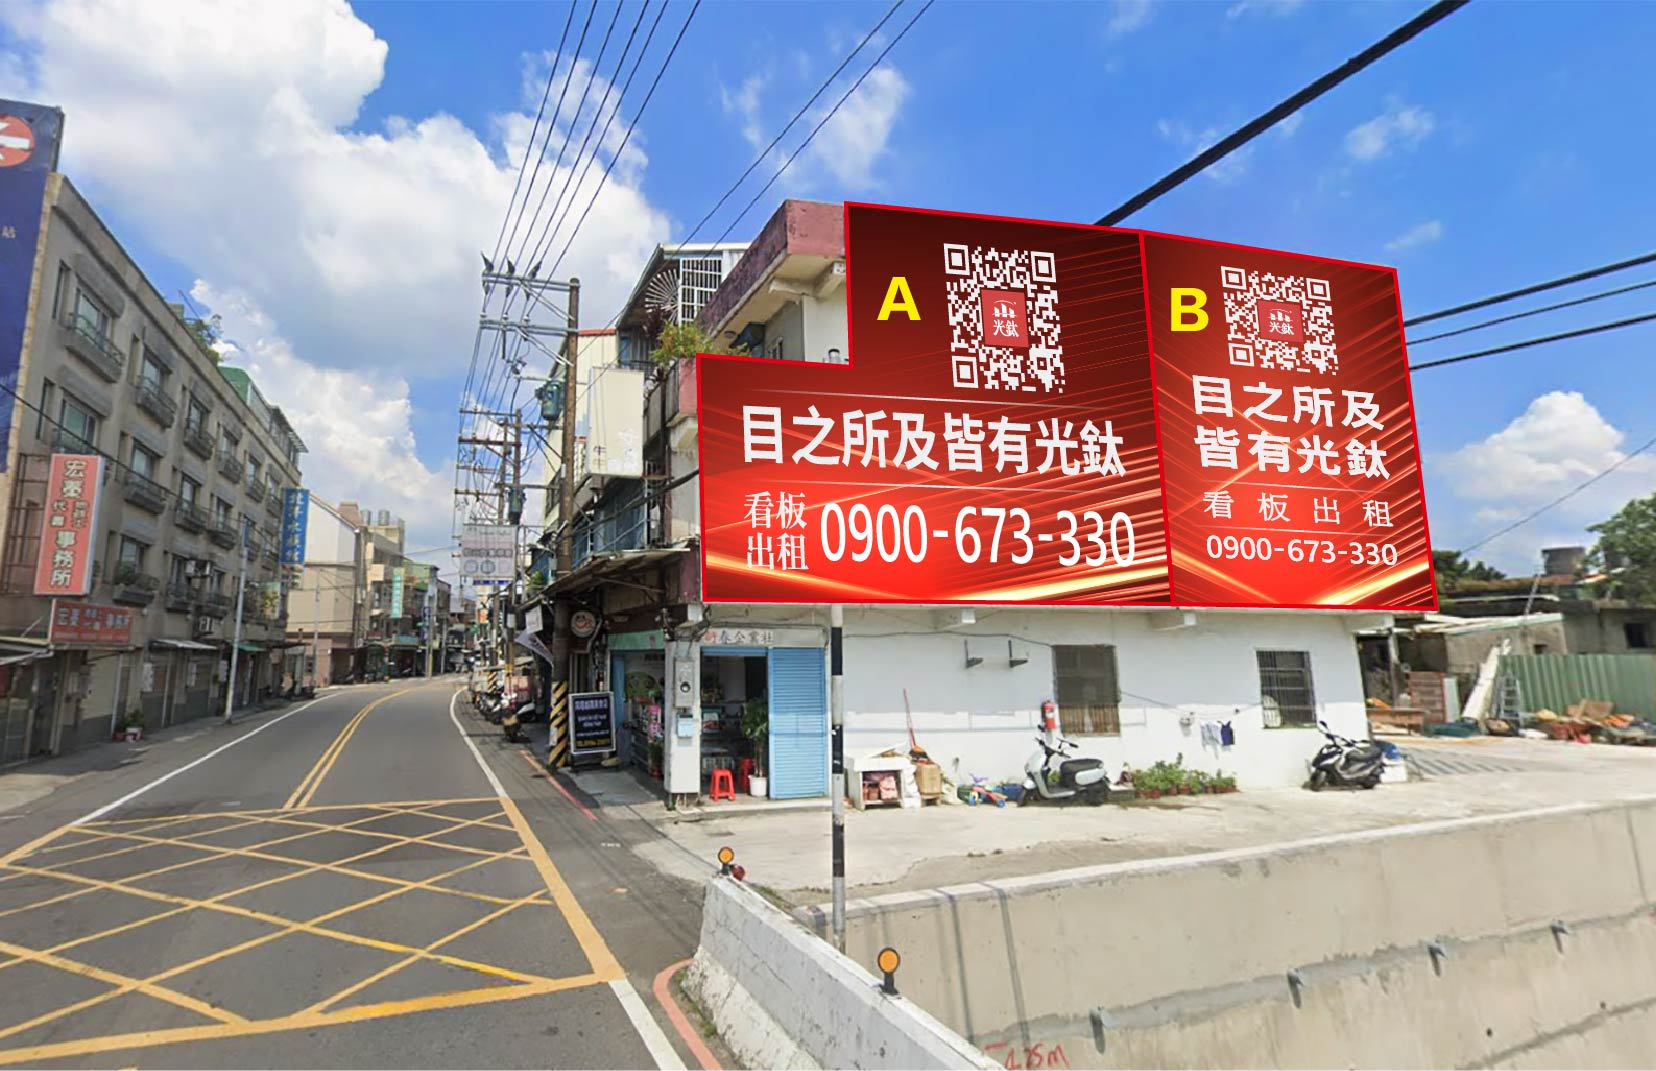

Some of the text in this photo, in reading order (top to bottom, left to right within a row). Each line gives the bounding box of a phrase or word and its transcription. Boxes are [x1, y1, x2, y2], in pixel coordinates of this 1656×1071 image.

[877, 277, 920, 320] A
[1171, 288, 1208, 331] B
[1193, 375, 1384, 432] 目之所及
[742, 405, 1127, 478] 目之所及皆有光鈦
[1194, 425, 1390, 481] 皆有光鈦
[744, 491, 807, 529] 看板
[746, 533, 809, 571] 出租
[820, 502, 1135, 568] 0900-673-330
[1206, 536, 1398, 567] 0900-673-330
